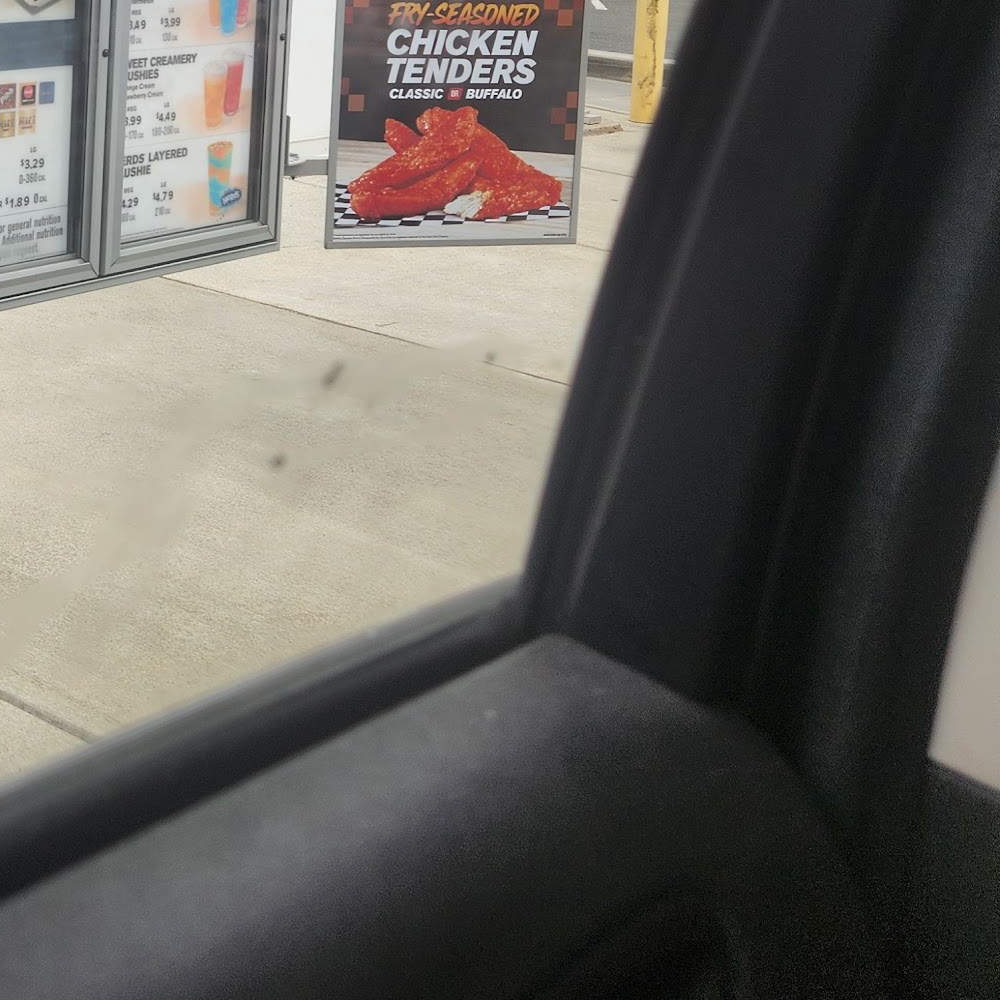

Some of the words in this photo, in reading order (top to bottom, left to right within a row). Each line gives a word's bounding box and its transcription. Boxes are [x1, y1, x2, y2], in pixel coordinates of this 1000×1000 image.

[389, 2, 540, 27] FRY-SEASONED
[160, 17, 181, 28] $3.99
[386, 28, 538, 56] CHICKEN
[150, 53, 197, 68] CREAMERY
[386, 58, 537, 84] TENDERS
[389, 88, 444, 100] CLASSIC
[466, 89, 522, 100] BUFFALO
[148, 147, 188, 162] LAYERED
[20, 158, 44, 170] $3.29
[5, 196, 29, 208] $1.89
[7, 218, 32, 233] general
